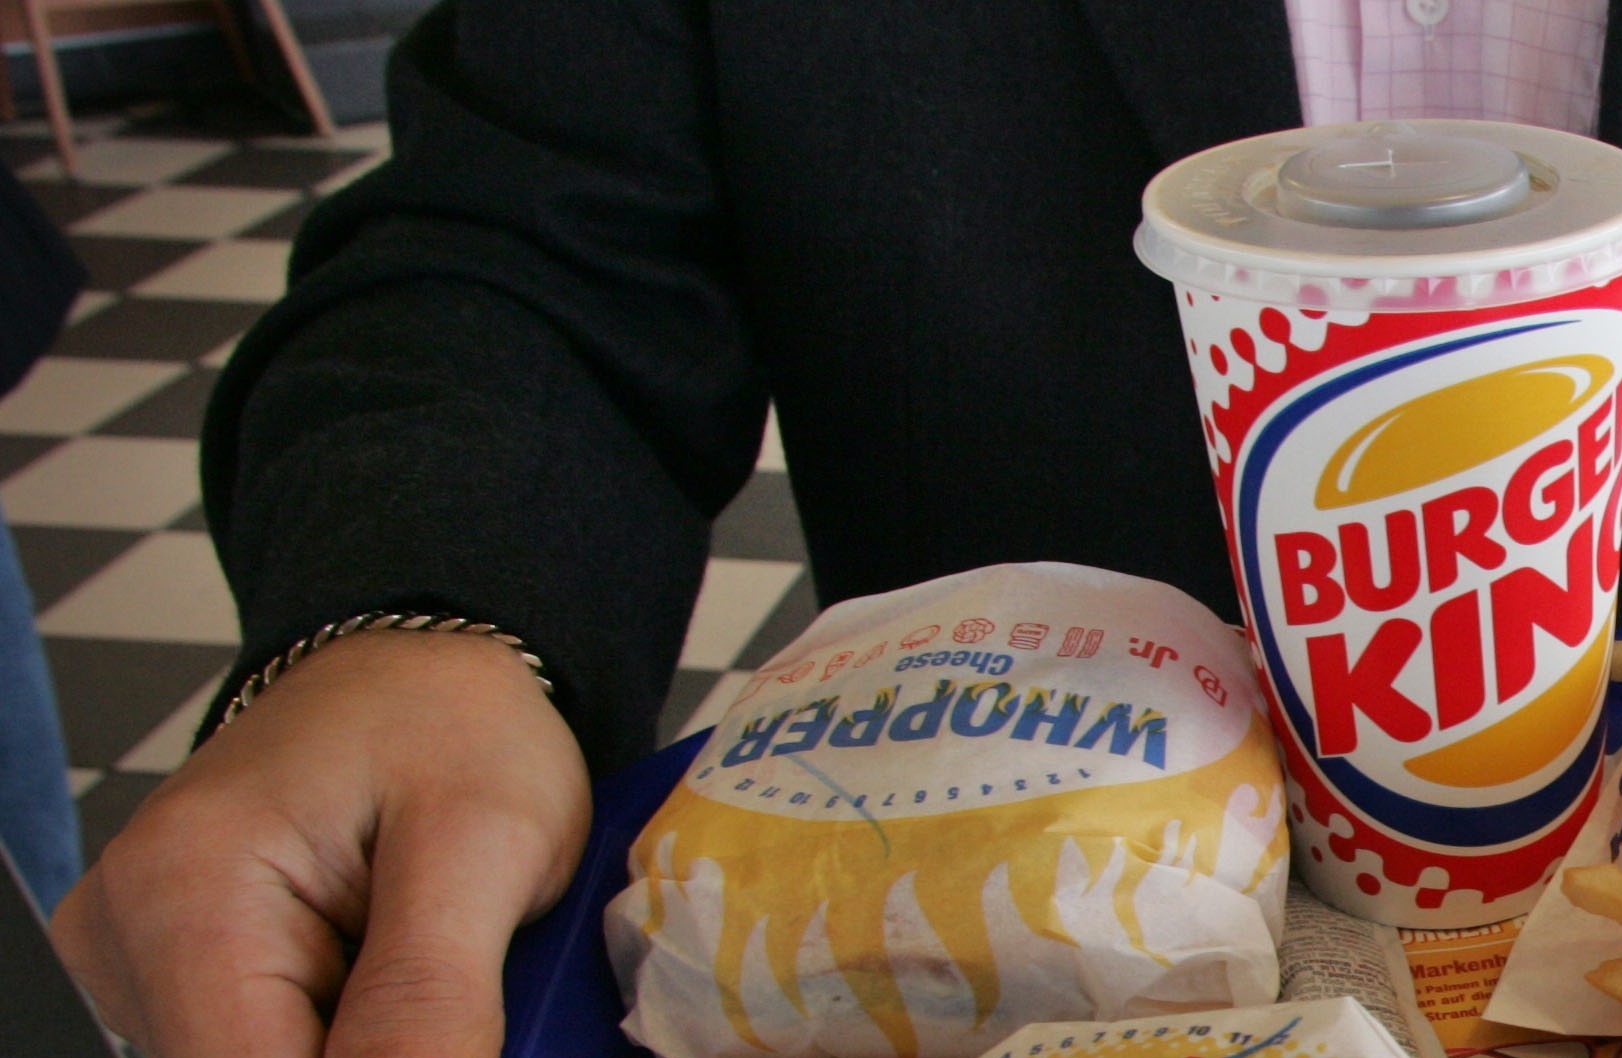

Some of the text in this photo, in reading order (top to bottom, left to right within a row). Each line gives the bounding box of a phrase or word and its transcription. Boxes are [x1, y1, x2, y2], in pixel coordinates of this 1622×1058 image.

[894, 649, 1014, 676] Cheese
[1128, 637, 1180, 669] Jr.
[720, 678, 1168, 771] WHOPPER
[1425, 980, 1480, 995] Palmen
[1440, 993, 1466, 1006] auf
